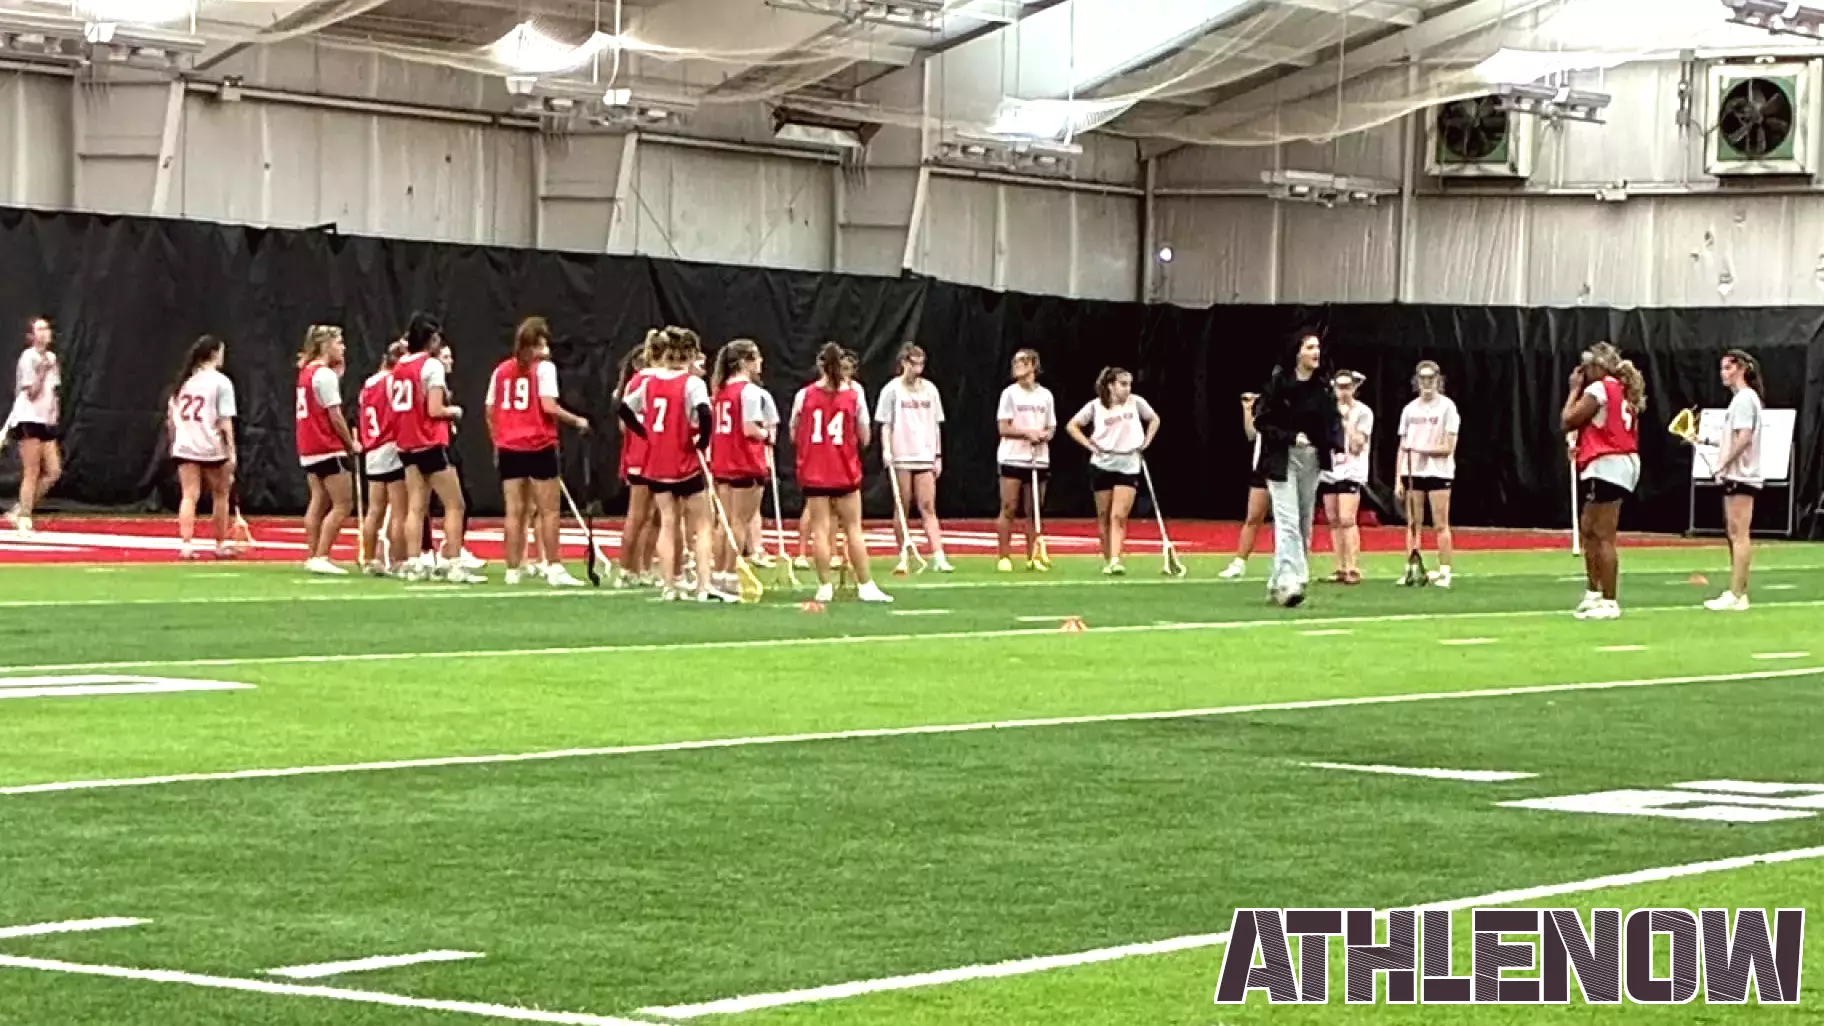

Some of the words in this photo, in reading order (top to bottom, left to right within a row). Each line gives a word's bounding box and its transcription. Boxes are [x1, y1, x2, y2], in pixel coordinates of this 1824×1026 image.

[180, 394, 205, 421] 22
[501, 378, 529, 410] 19
[366, 406, 380, 437] 3
[653, 397, 668, 432] 7
[714, 400, 732, 434] 15
[811, 409, 844, 445] 14
